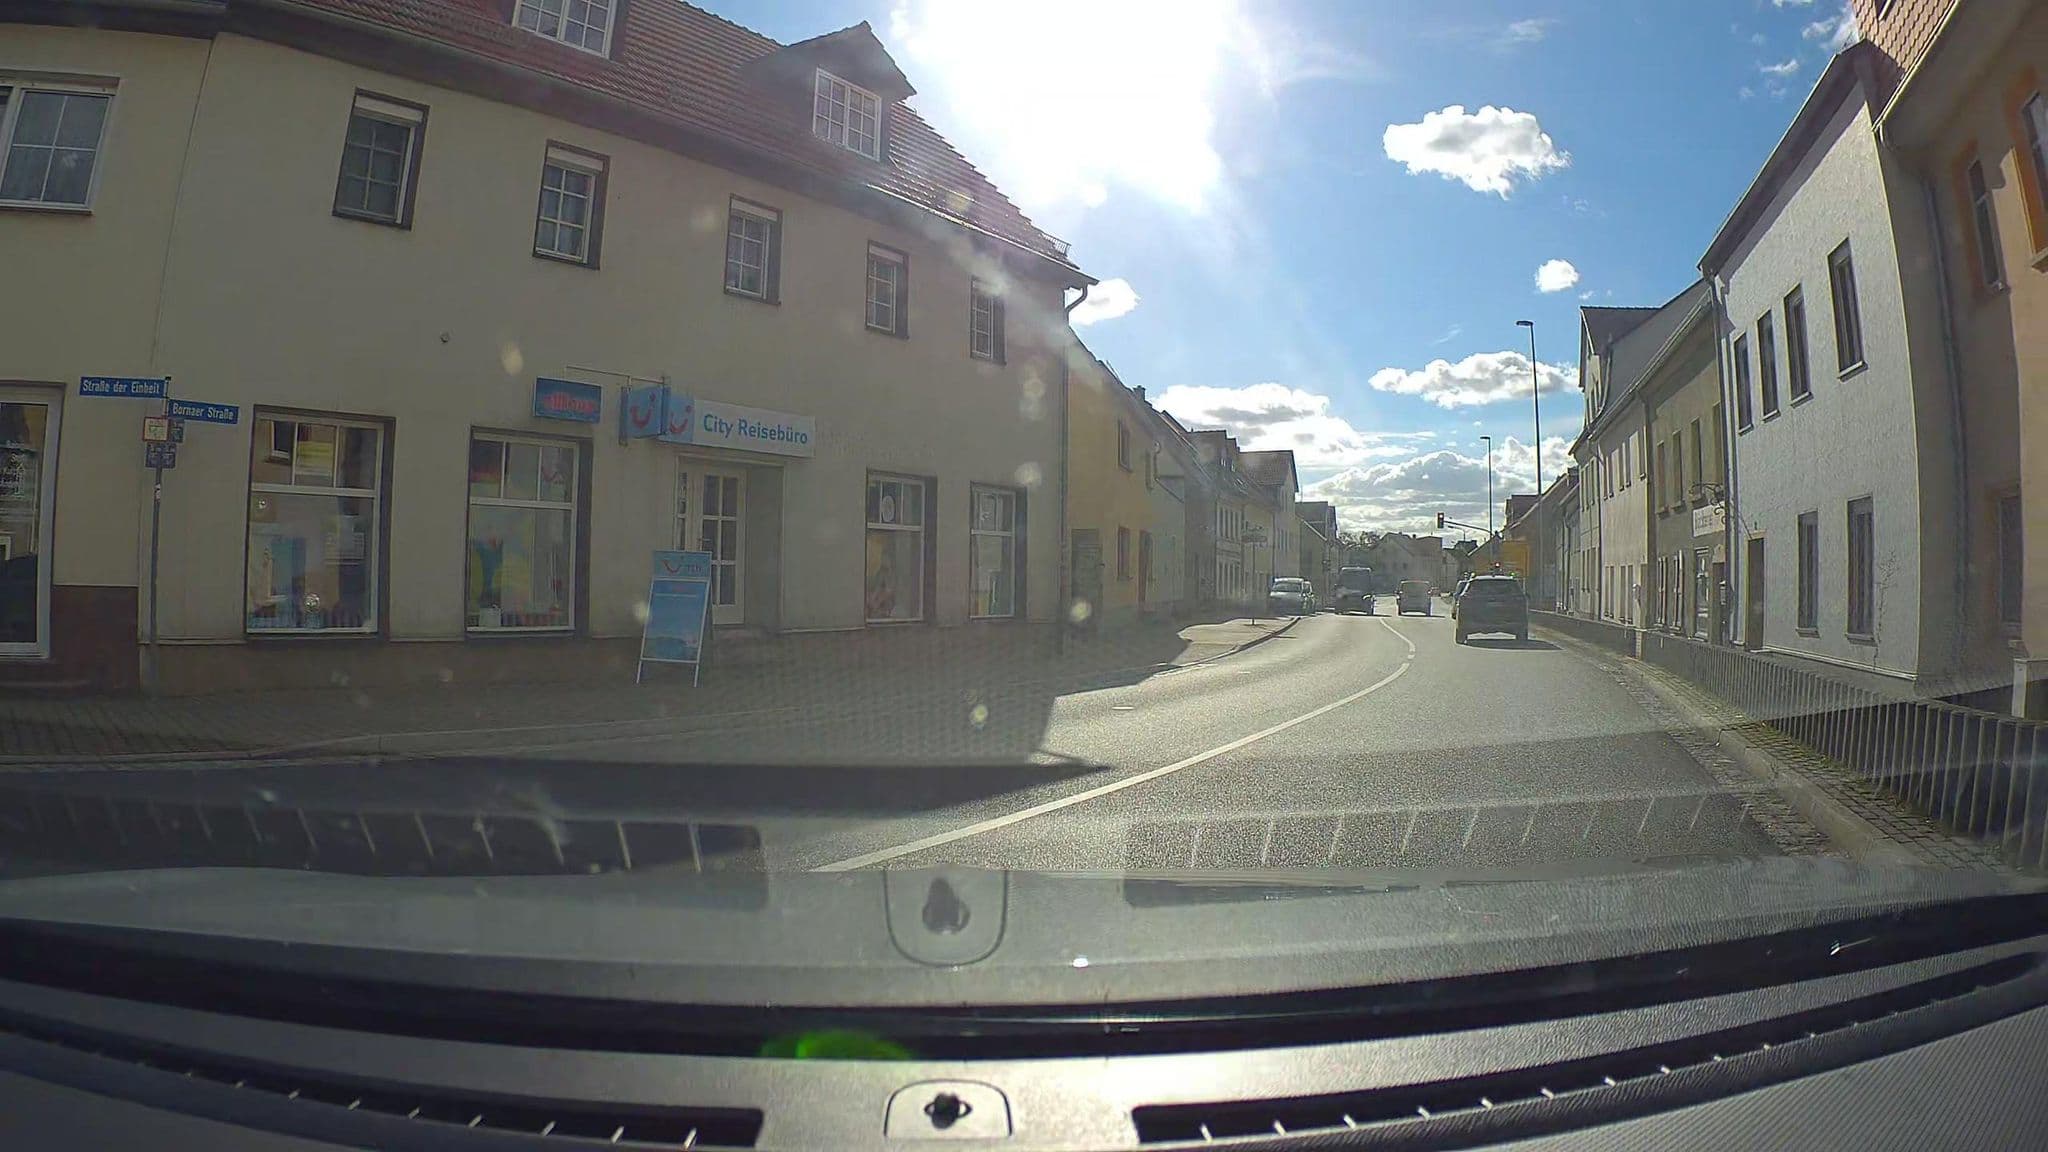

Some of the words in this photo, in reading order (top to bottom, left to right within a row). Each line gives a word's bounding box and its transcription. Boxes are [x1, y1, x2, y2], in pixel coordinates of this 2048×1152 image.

[82, 380, 110, 392] Straße
[113, 381, 127, 393] der
[131, 381, 160, 394] Einheit
[172, 402, 205, 417] Bornaer
[207, 406, 234, 420] Straße
[703, 413, 734, 438] City
[738, 417, 809, 444] Reisebüro
